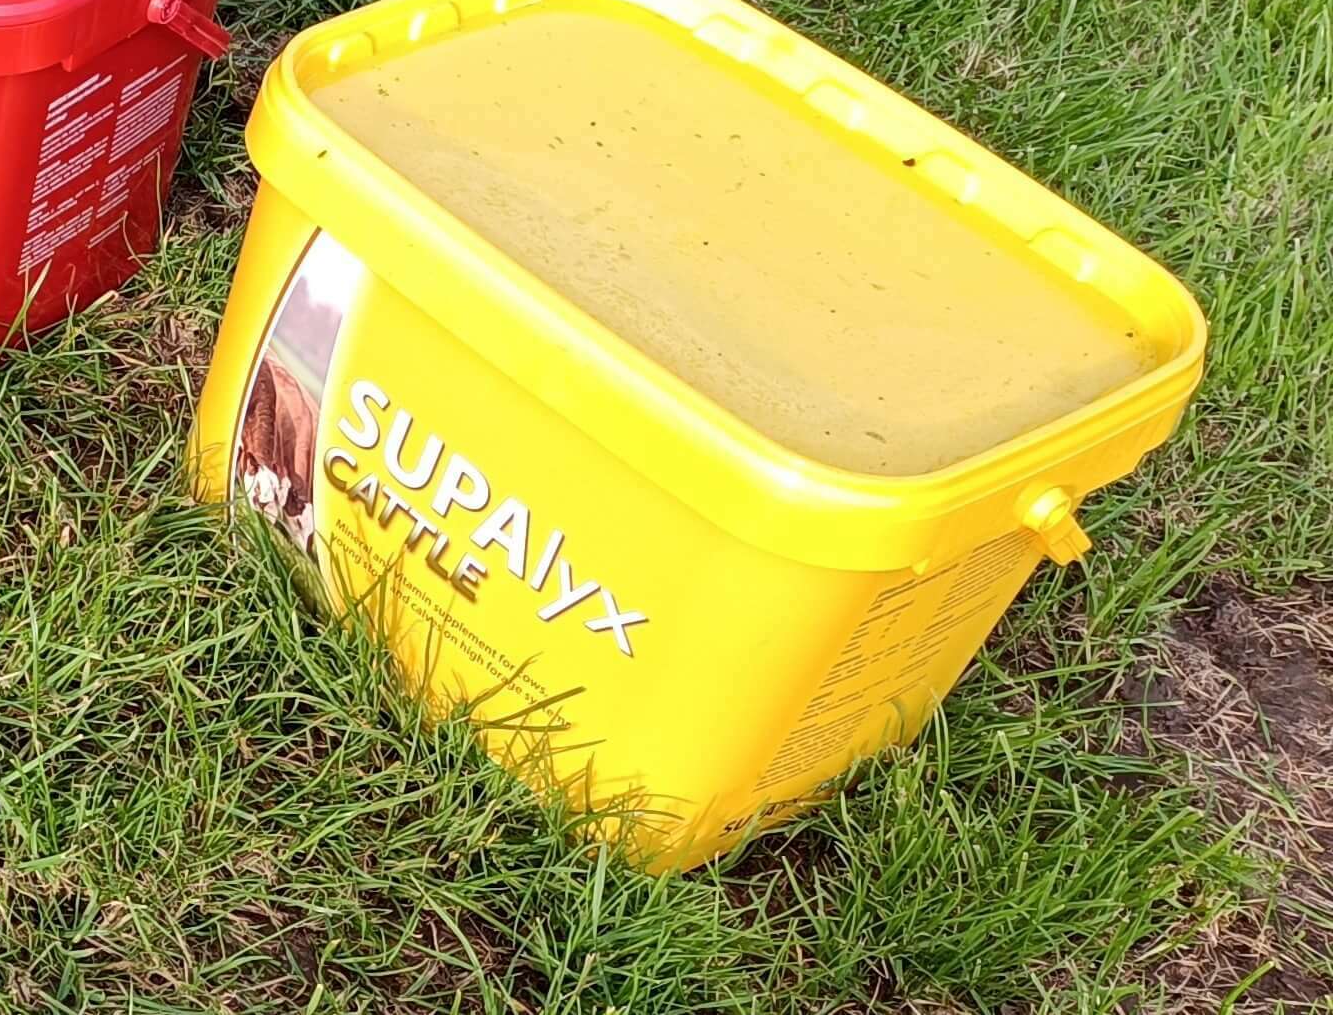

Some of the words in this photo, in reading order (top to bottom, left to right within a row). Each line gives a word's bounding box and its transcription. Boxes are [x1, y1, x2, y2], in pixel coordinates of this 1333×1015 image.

[322, 445, 490, 602] CATTLE
[331, 532, 362, 565] young
[390, 586, 410, 604] and
[444, 630, 458, 645] on
[459, 639, 484, 664] high
[337, 378, 650, 659] SUPAlyx
[335, 519, 372, 556] Mineral
[395, 569, 432, 606] vitamin
[434, 604, 497, 658] supplement
[499, 654, 515, 671] for
[517, 671, 548, 697] ows,
